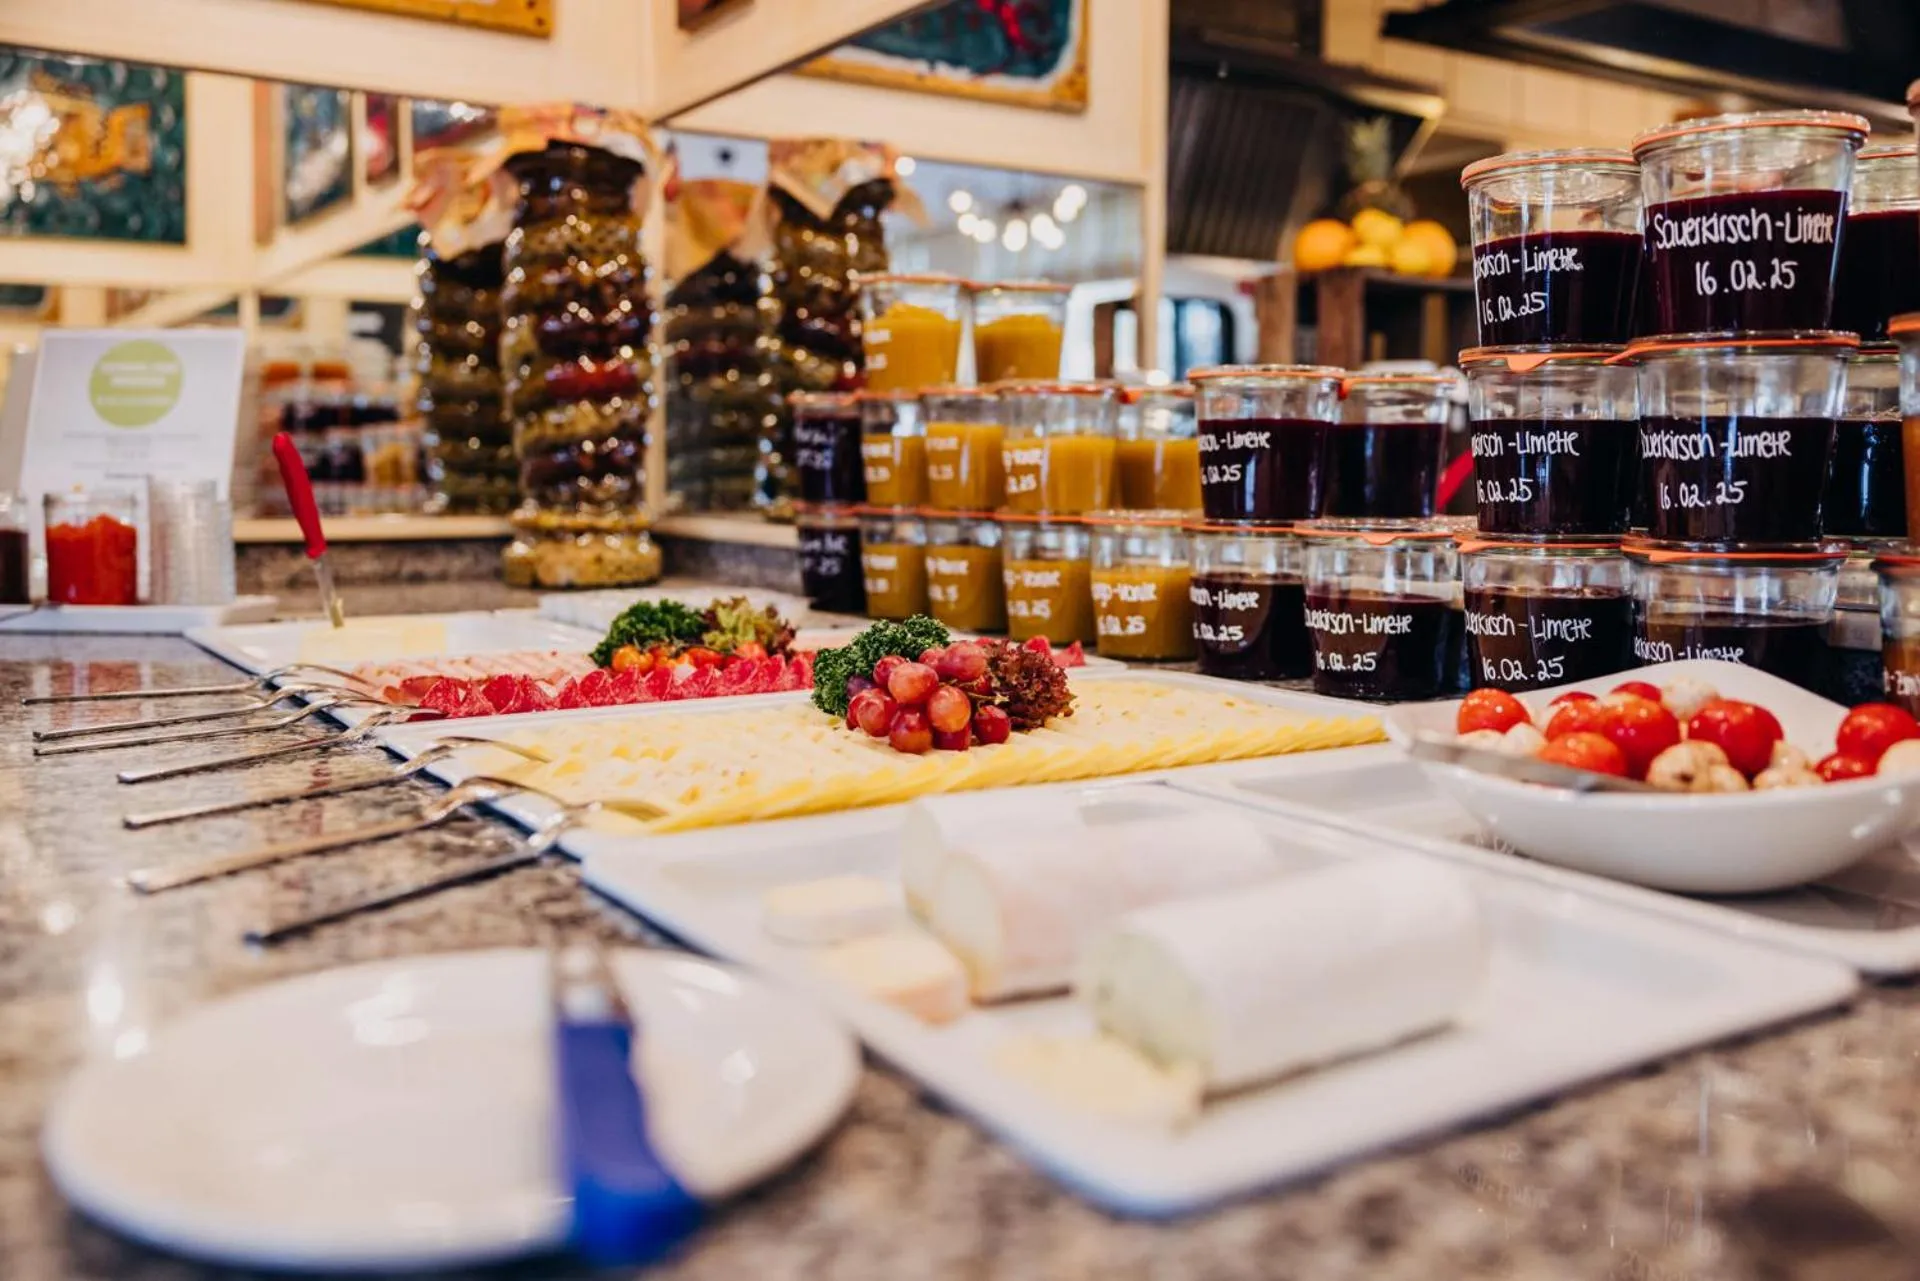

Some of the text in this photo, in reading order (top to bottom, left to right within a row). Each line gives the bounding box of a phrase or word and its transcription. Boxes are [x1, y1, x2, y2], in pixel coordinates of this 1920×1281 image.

[1654, 206, 1834, 249] Sauerkirsch-Limette
[1695, 257, 1798, 296] 16.02.25
[1482, 291, 1548, 325] 16.02.25
[1660, 480, 1748, 510] 16.02.25
[1481, 655, 1565, 681] 16.02.25
